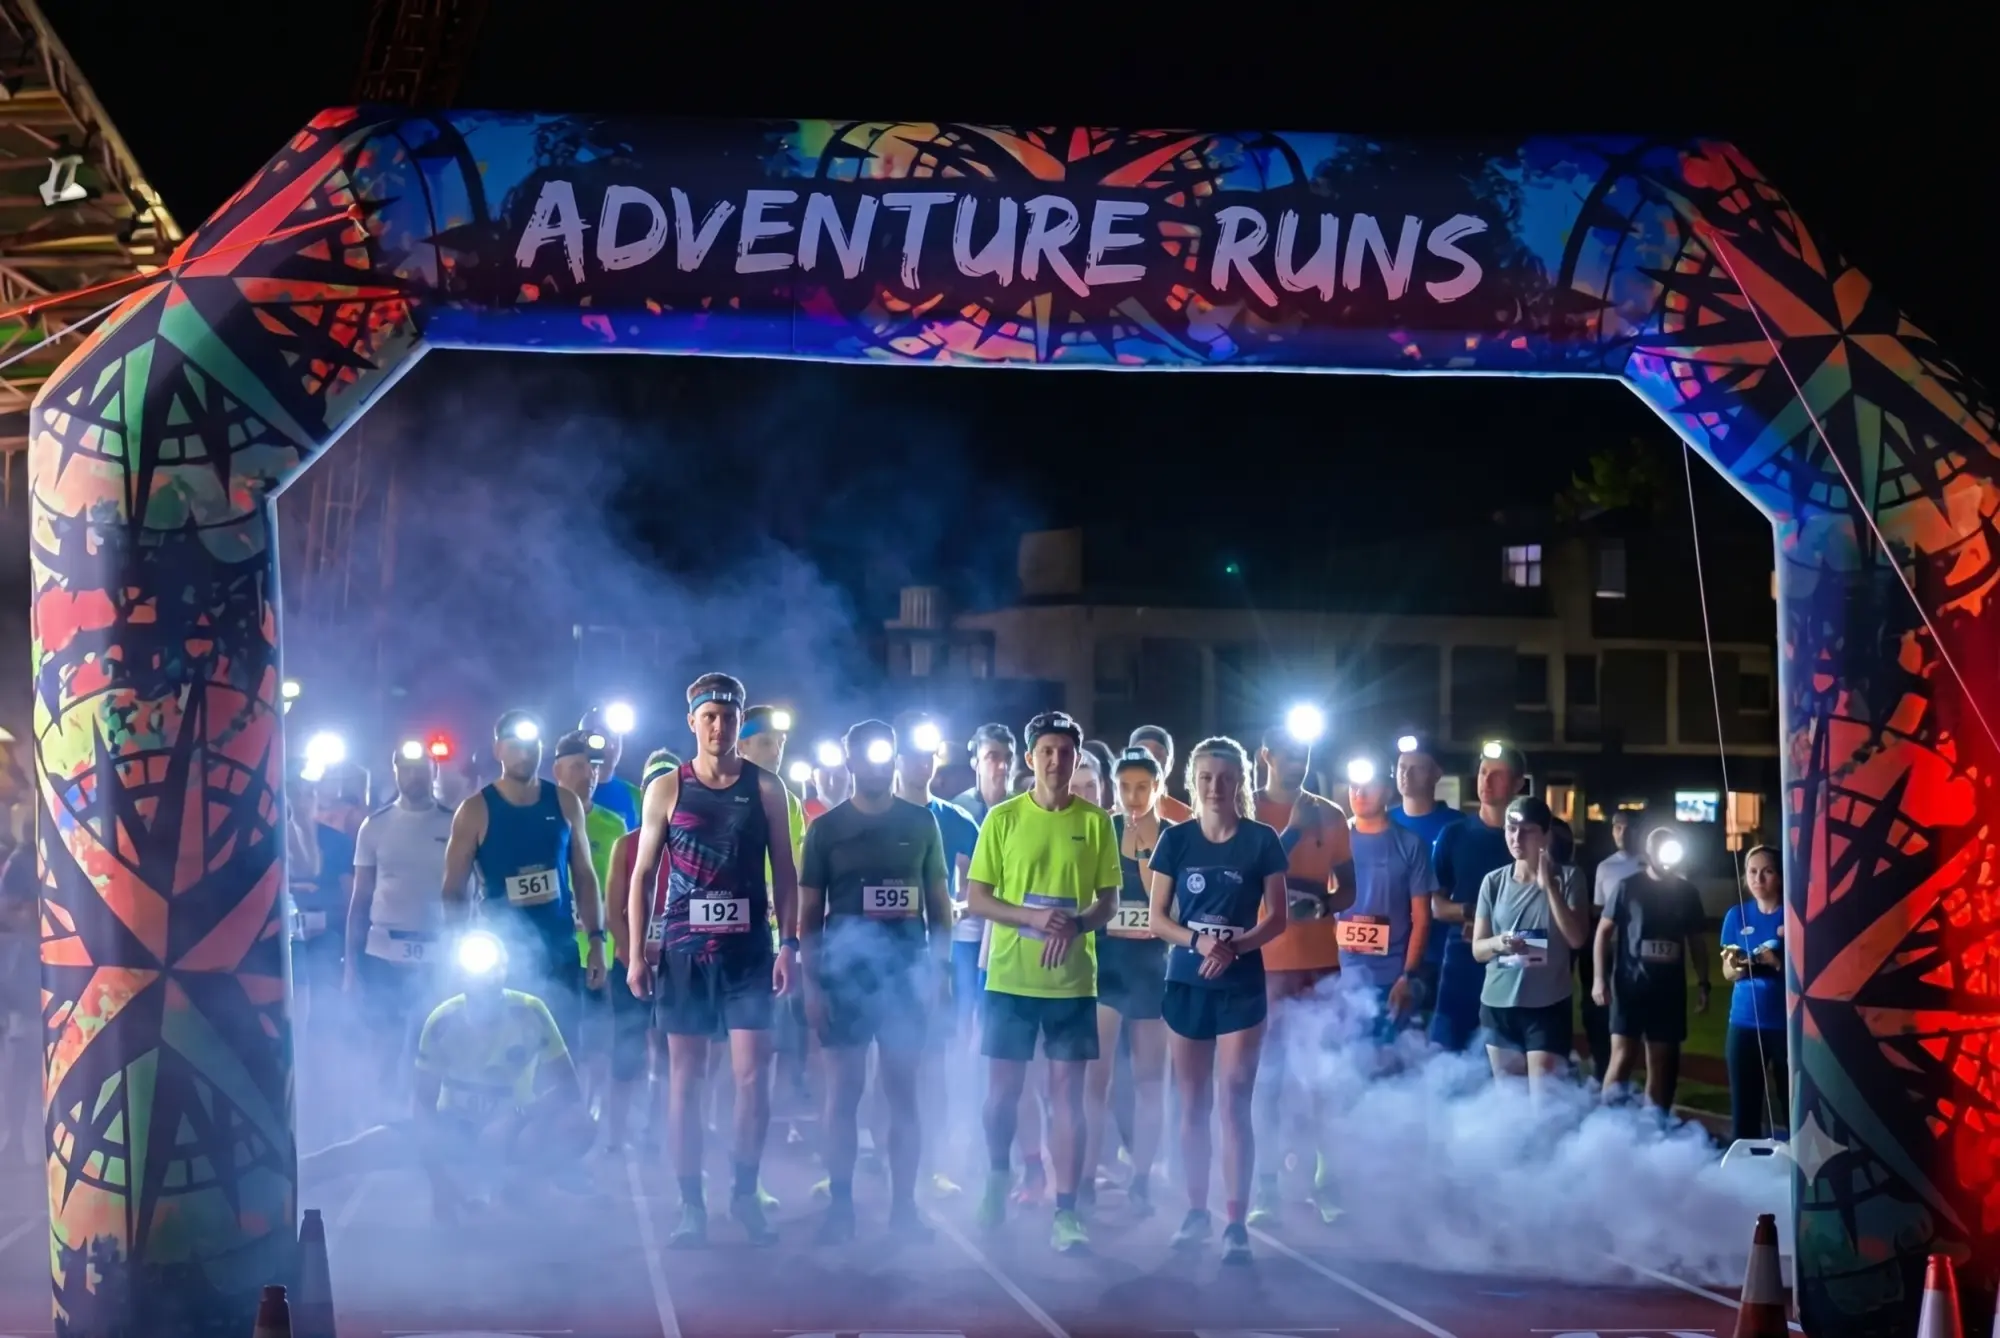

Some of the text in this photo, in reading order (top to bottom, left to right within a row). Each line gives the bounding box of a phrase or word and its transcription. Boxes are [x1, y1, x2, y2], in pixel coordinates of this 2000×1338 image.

[515, 180, 1488, 306] ADVENTURE RUNS
[518, 874, 549, 895] 561
[875, 888, 909, 907] 595
[701, 902, 738, 921] 192
[1345, 925, 1379, 944] 552
